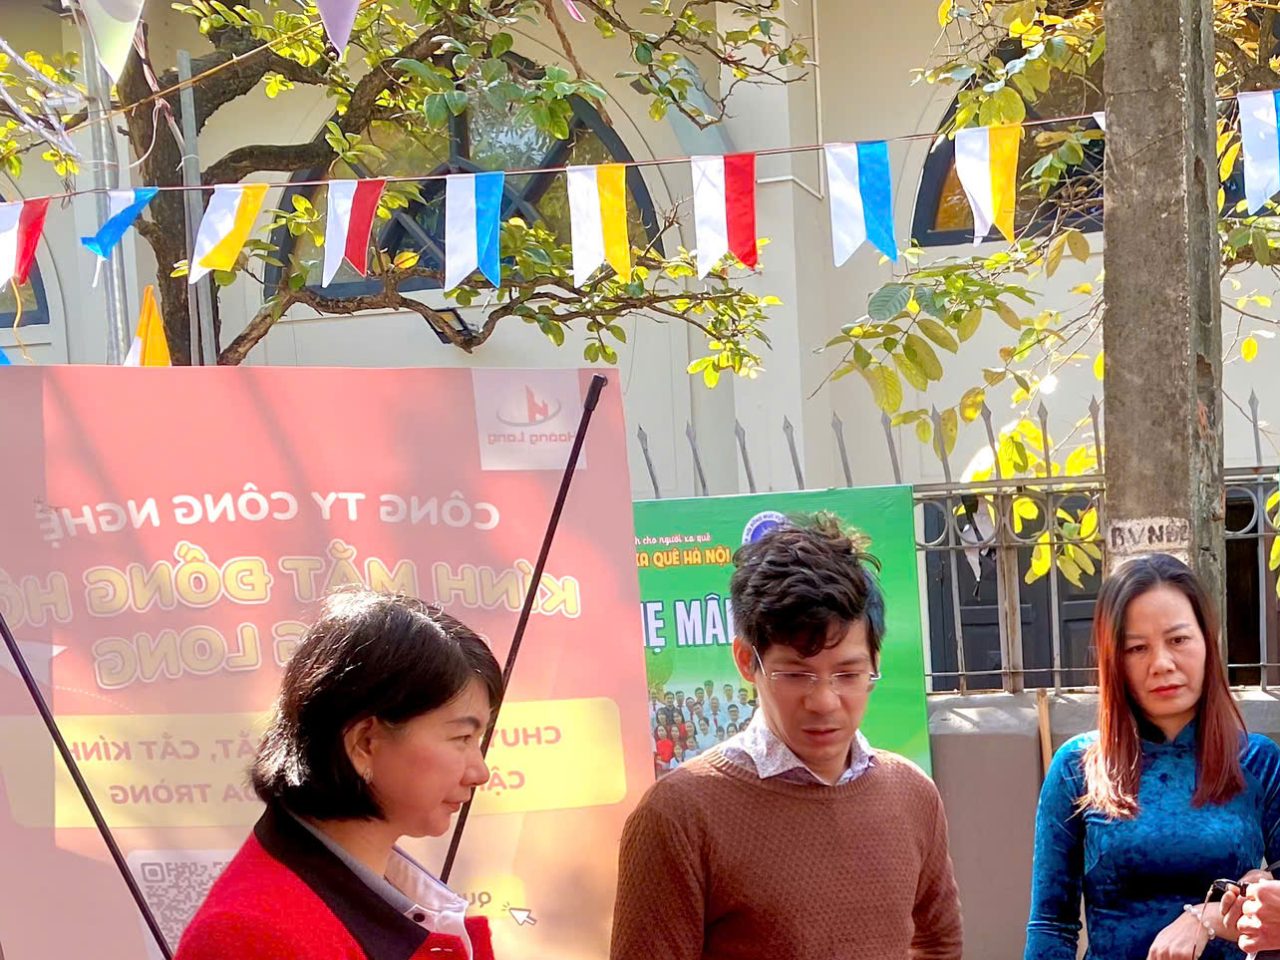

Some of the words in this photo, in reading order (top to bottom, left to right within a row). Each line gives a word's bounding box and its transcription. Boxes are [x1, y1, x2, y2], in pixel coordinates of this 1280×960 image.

[643, 534, 657, 545] cho
[684, 535, 695, 543] xa
[696, 532, 711, 544] quê
[653, 547, 680, 568] QUÊ
[684, 547, 703, 566] HÀ
[705, 545, 732, 568] NỘI
